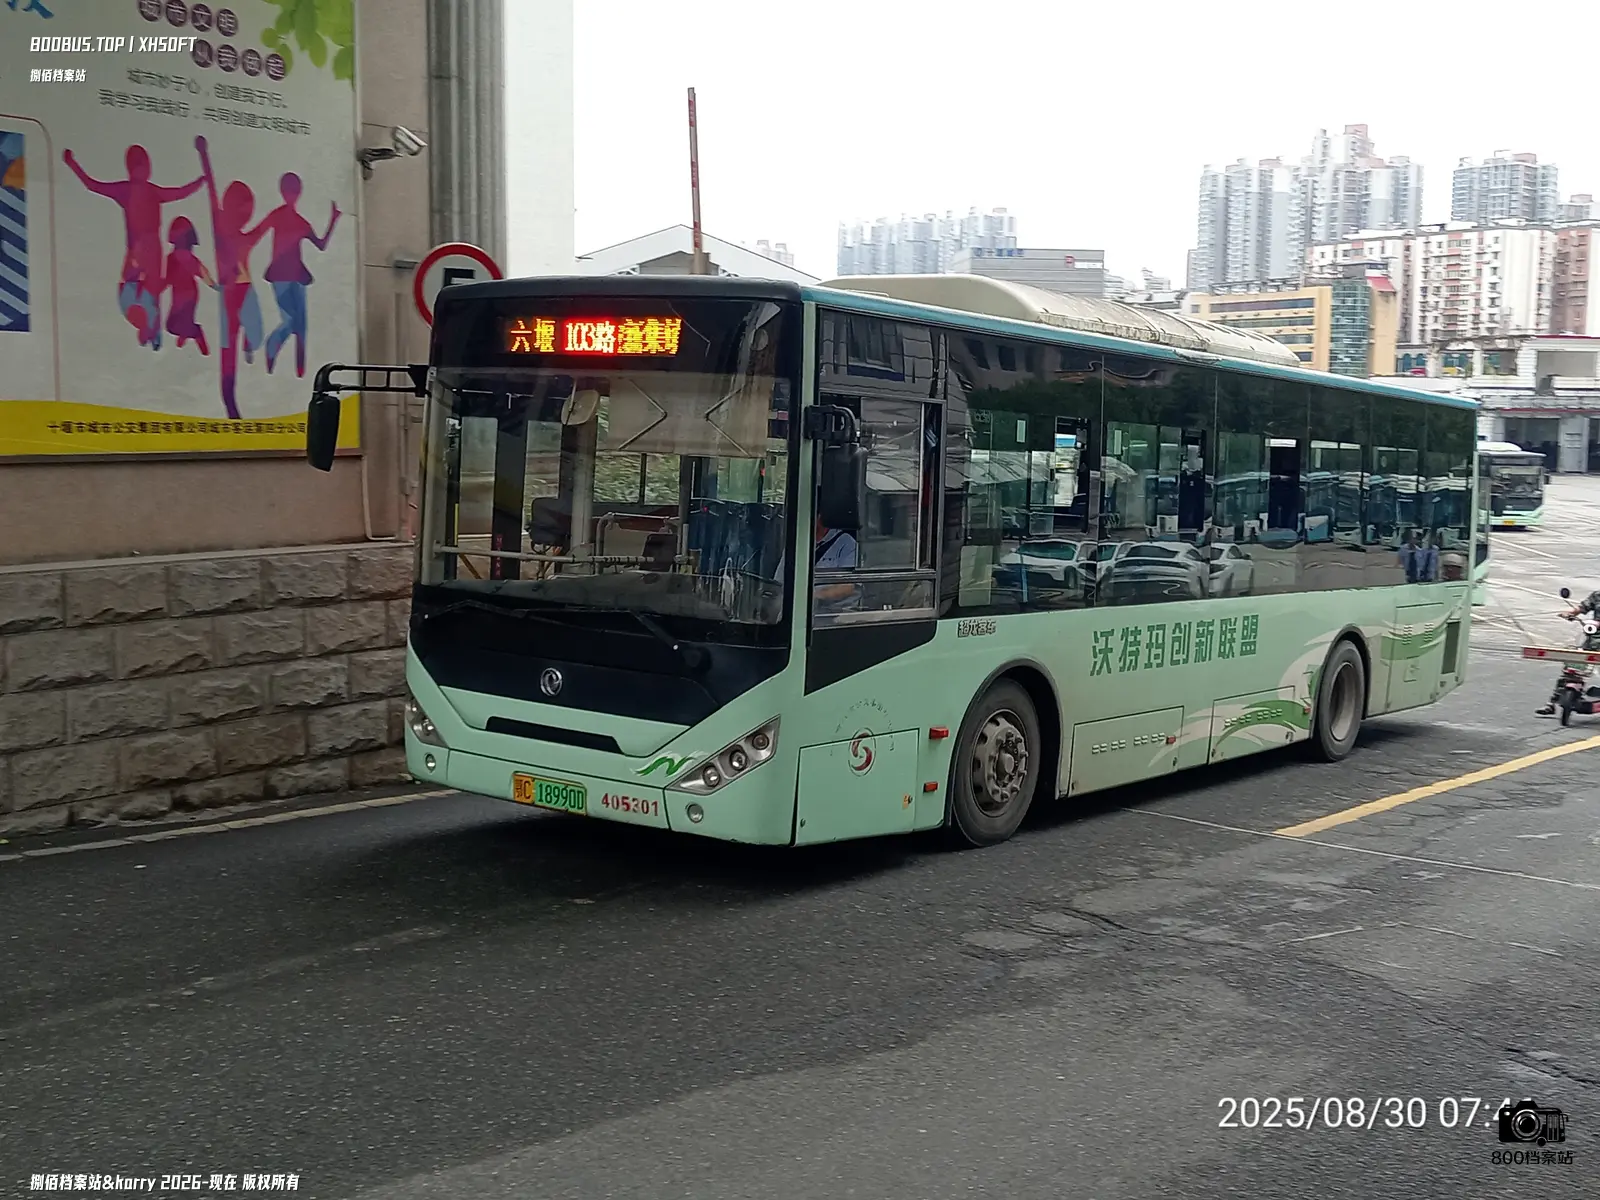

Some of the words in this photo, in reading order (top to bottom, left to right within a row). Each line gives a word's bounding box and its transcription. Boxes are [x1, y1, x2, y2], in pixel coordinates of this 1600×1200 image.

[510, 318, 556, 353] 六堰
[564, 320, 616, 354] 103路
[957, 618, 997, 638] 超龙客车
[1089, 614, 1260, 677] 沃特玛创新联盟
[537, 782, 585, 811] 18990D
[601, 792, 659, 817] 405301
